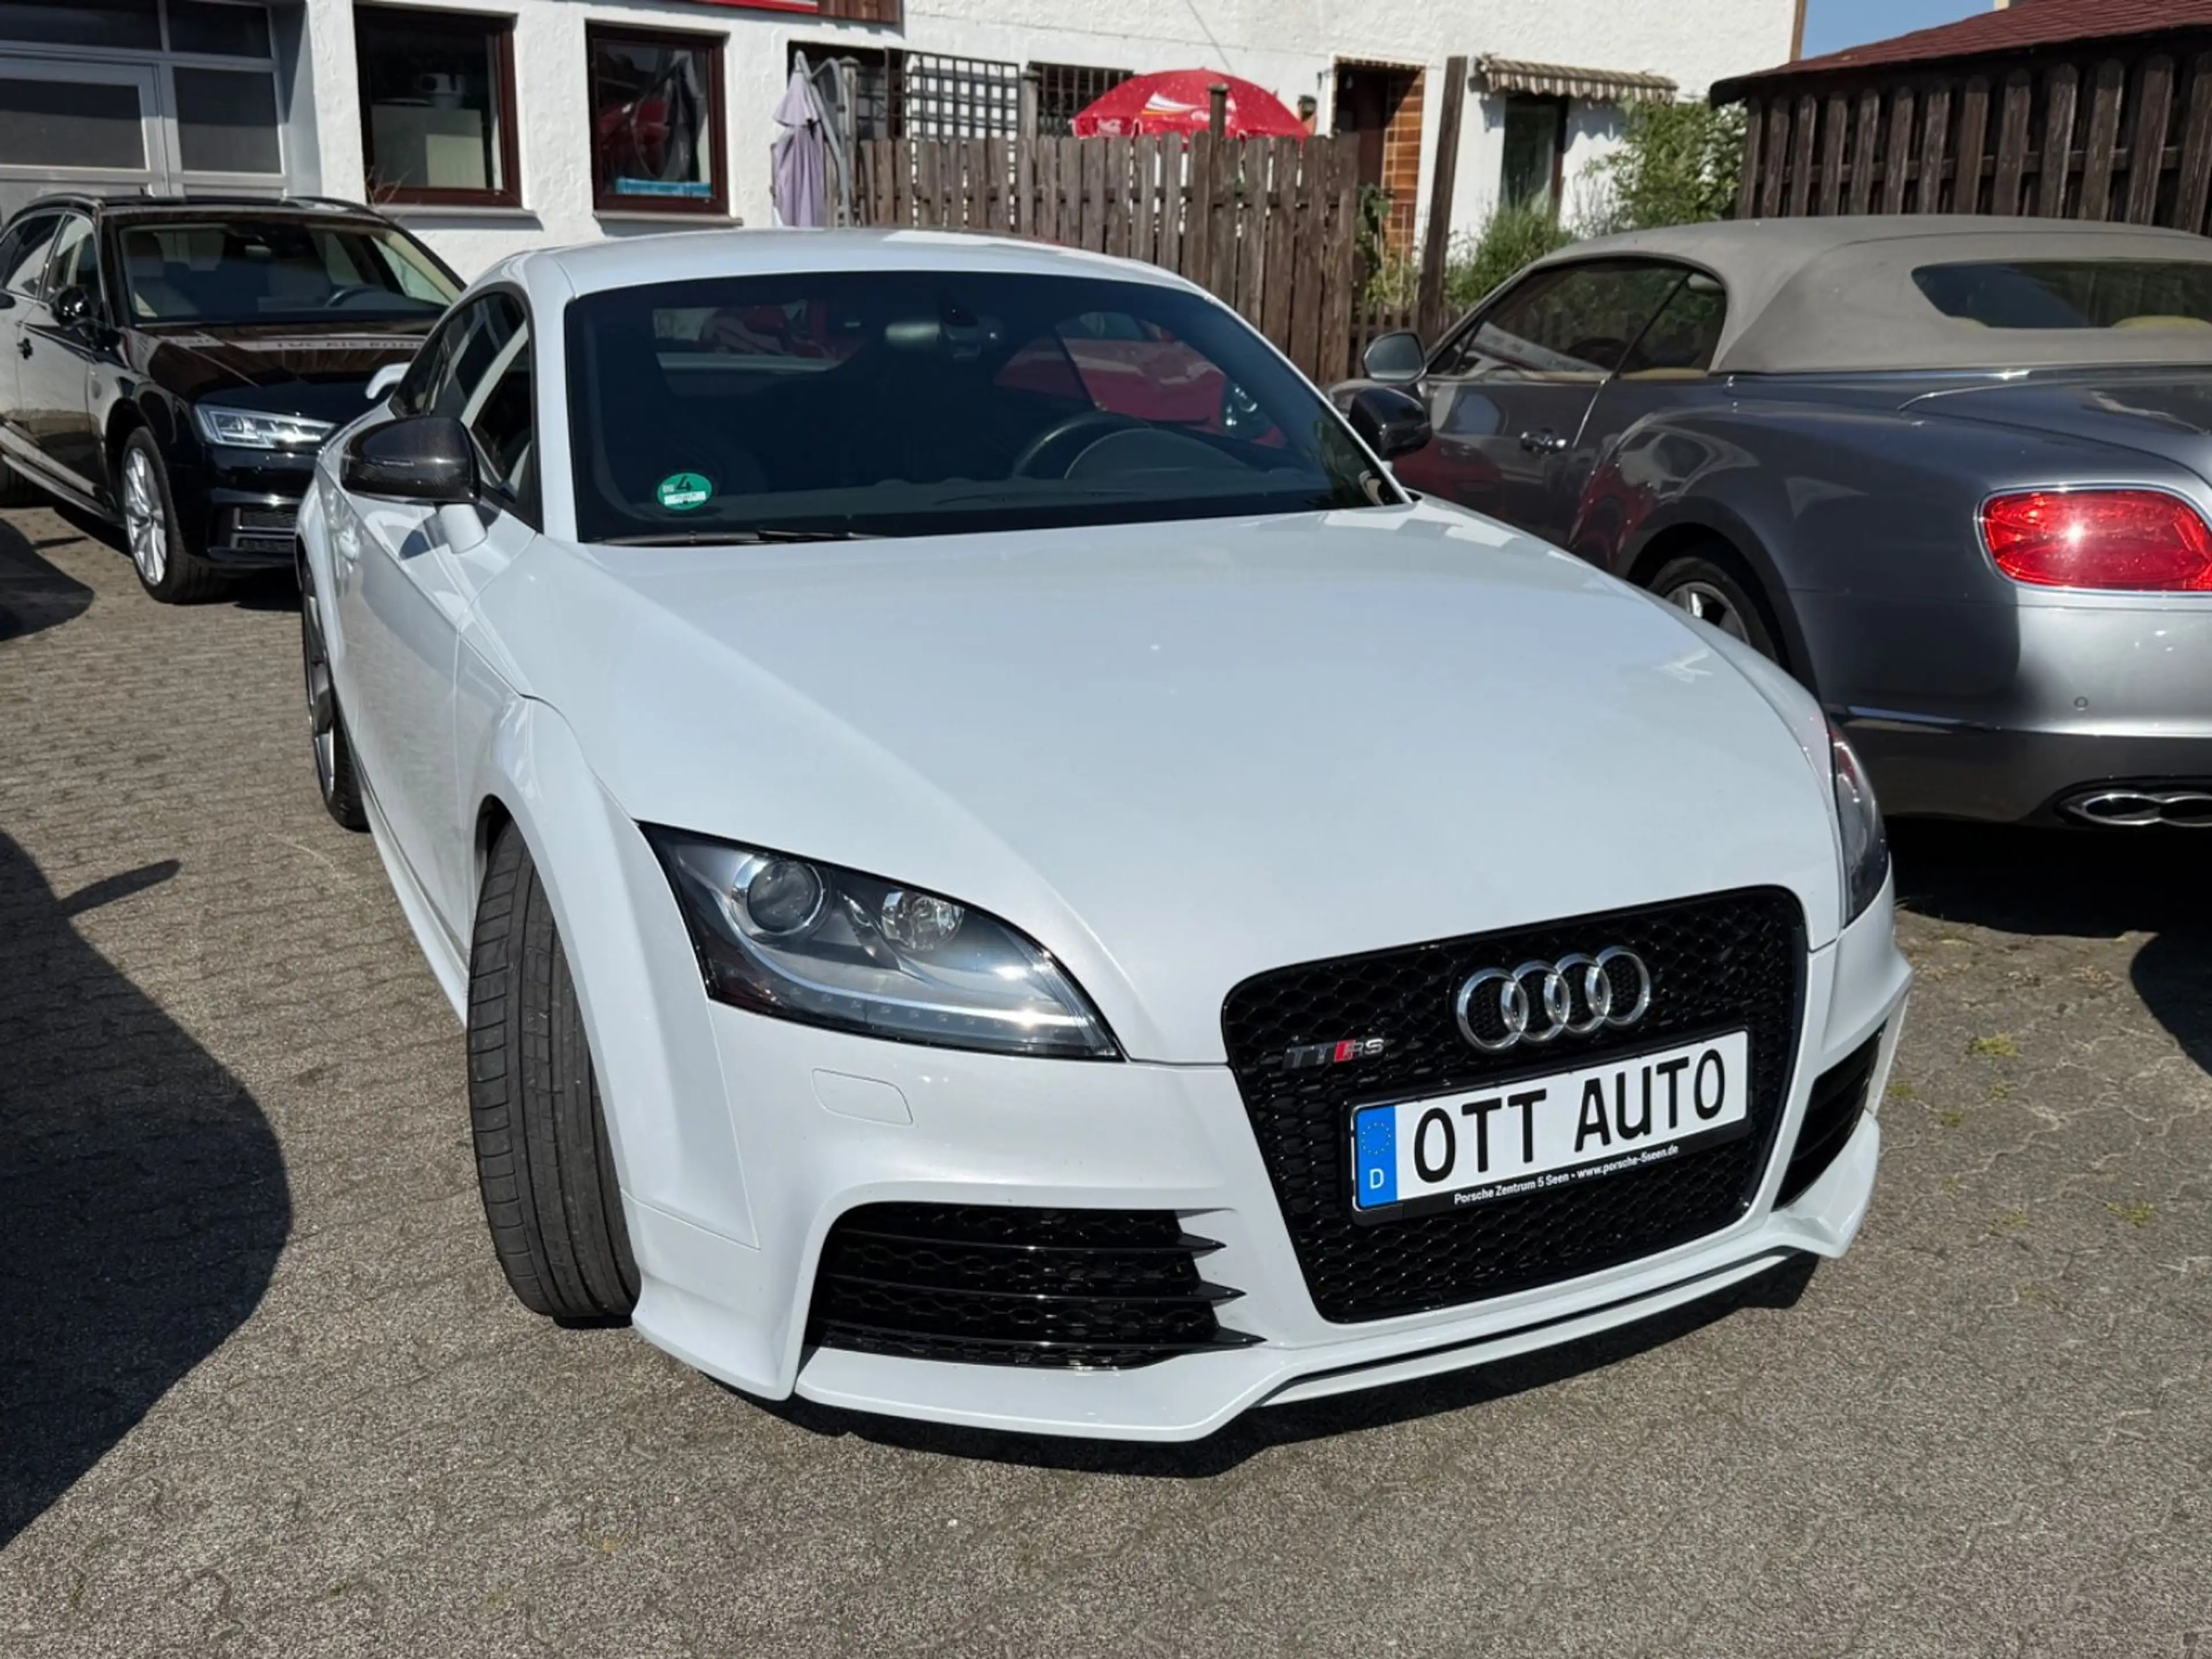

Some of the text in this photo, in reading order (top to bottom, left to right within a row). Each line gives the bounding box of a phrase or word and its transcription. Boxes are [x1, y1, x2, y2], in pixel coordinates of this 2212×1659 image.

[676, 474, 692, 491] 4
[1414, 1048, 1725, 1184] OTT AUTO
[1369, 1168, 1384, 1190] D
[1454, 1187, 1494, 1205] Porsche
[1494, 1180, 1536, 1197] Zentrum
[1537, 1177, 1544, 1188] 5
[1546, 1172, 1570, 1186] Seen
